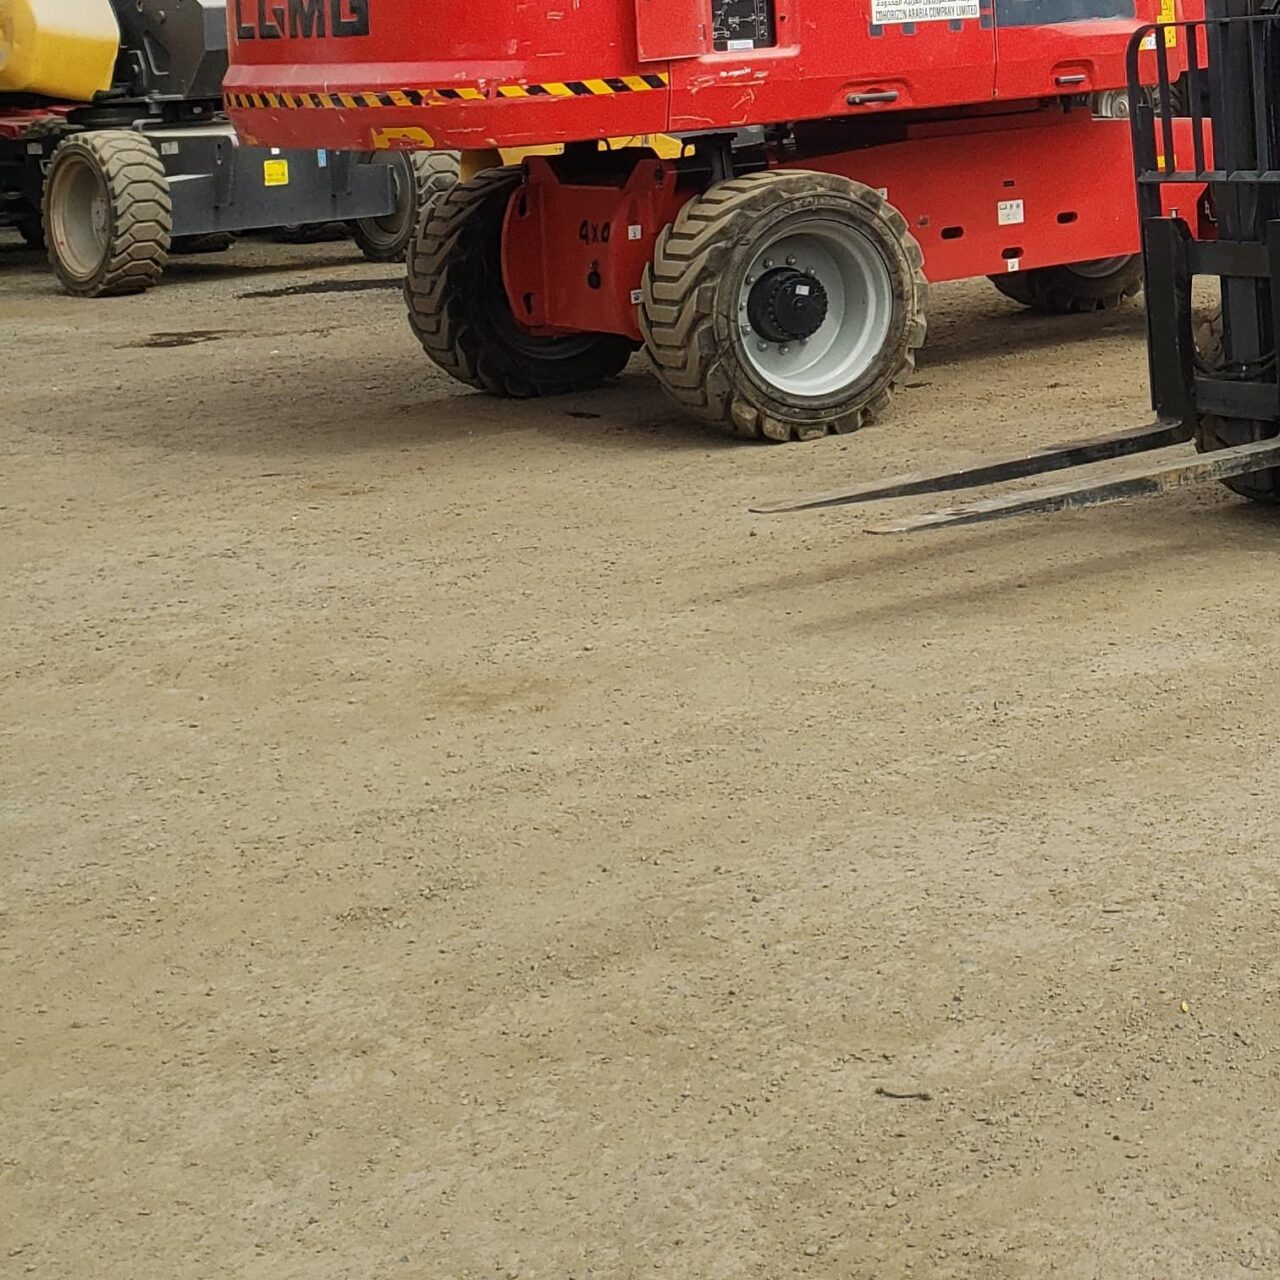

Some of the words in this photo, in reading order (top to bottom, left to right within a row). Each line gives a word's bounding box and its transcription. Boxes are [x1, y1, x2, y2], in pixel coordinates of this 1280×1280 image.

[908, 7, 928, 20] ARABIA
[929, 5, 955, 18] COMPANY
[956, 4, 977, 17] LIMITED
